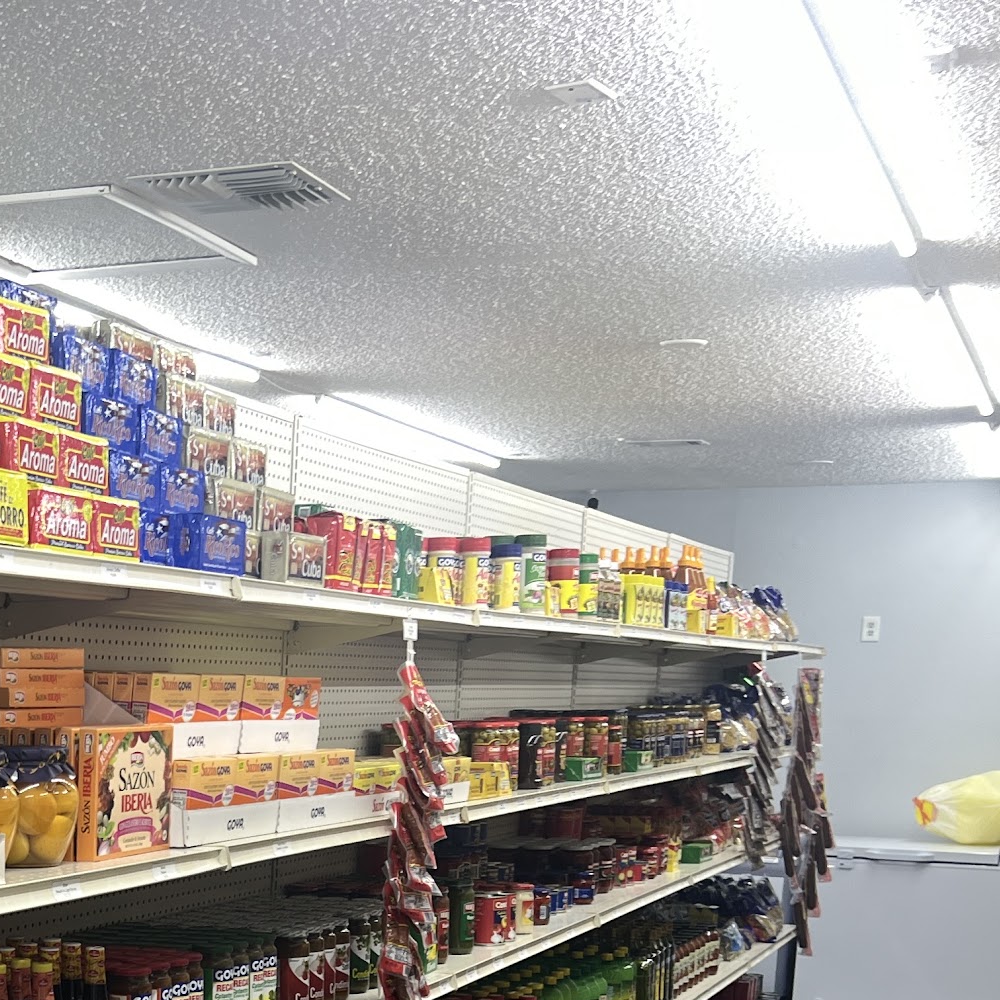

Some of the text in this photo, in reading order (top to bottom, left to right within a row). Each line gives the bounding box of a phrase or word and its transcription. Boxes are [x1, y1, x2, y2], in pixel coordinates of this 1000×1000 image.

[8, 326, 46, 354] Aroma
[41, 391, 78, 418] Aroma
[20, 451, 56, 475] Aroma
[69, 460, 105, 484] Aroma
[203, 457, 225, 477] Cuba
[46, 510, 87, 540] Aroma
[101, 521, 135, 545] Aroma
[302, 559, 321, 578] Cuba
[187, 736, 204, 748] GOYA
[274, 732, 289, 742] GOYA
[83, 758, 92, 797] IBERIA
[121, 793, 153, 814] IBERIA
[311, 807, 325, 818] GOYA
[227, 818, 244, 830] GOYA
